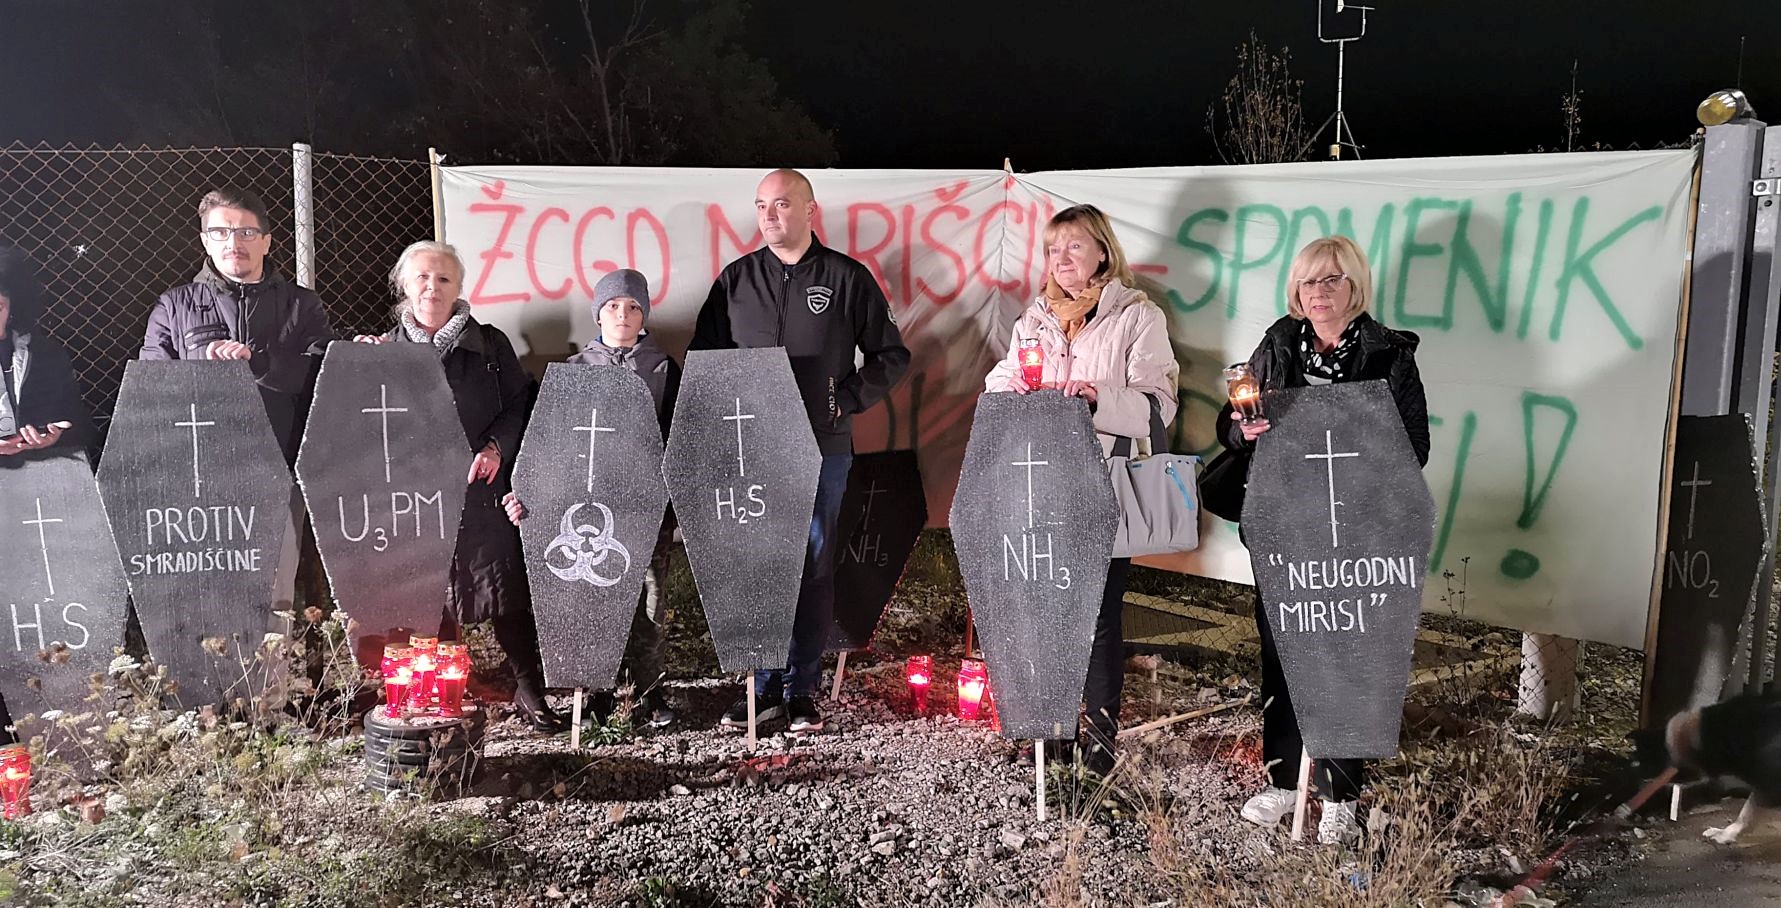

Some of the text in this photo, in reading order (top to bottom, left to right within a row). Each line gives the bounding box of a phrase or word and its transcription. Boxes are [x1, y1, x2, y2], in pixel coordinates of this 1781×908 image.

[146, 505, 256, 545] PROTIV
[338, 490, 445, 552] U3PM
[715, 484, 766, 524] H2S
[1003, 532, 1071, 590] NH3
[1667, 550, 1720, 598] NO2
